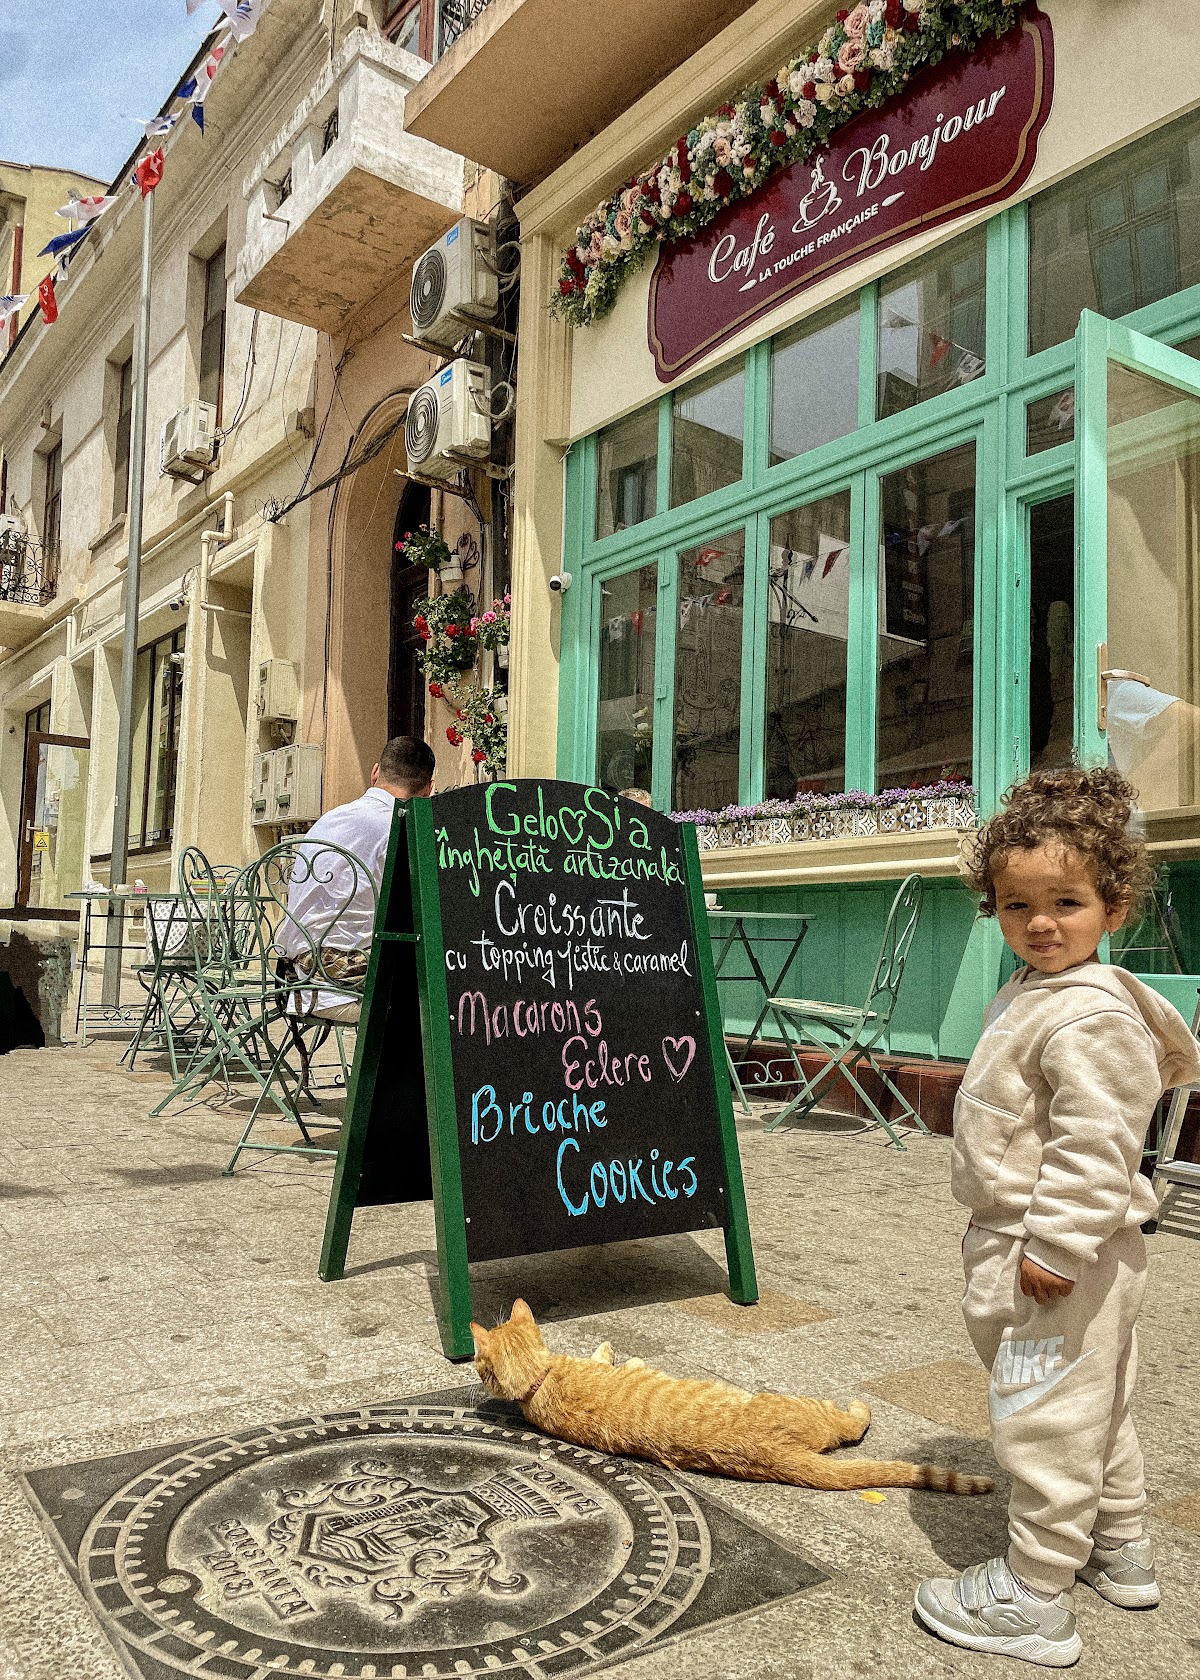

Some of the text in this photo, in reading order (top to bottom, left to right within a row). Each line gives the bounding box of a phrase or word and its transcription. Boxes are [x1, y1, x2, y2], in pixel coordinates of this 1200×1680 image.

[707, 85, 1006, 283] Café Bonjour
[759, 203, 879, 283] LA TOUCHE FRANÇAISE
[494, 880, 652, 940] Croissante
[445, 949, 467, 971] cu
[470, 930, 556, 989] topping
[612, 951, 623, 976] &
[623, 939, 693, 977] caramel
[458, 991, 602, 1046] Macarons
[562, 1035, 651, 1091] Eclere
[471, 1084, 608, 1145] Brioche
[556, 1137, 698, 1217] Cookies
[201, 1550, 254, 1595] 2013
